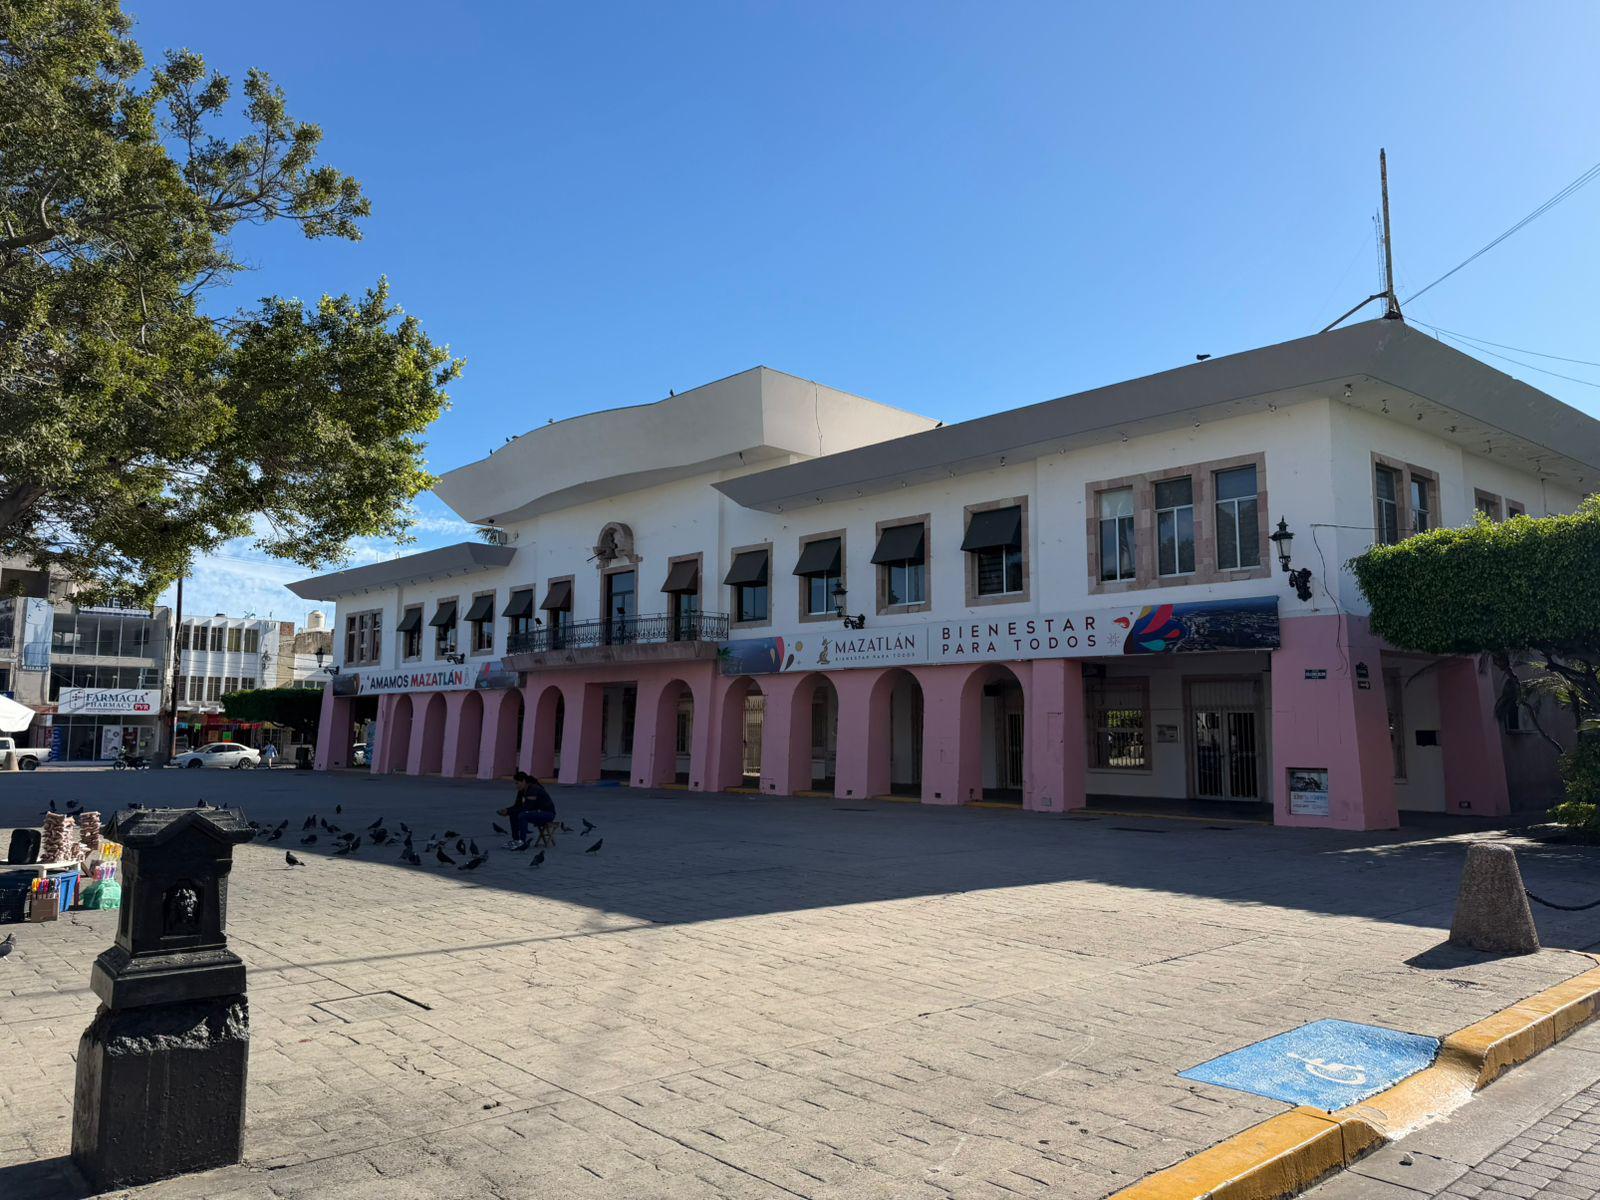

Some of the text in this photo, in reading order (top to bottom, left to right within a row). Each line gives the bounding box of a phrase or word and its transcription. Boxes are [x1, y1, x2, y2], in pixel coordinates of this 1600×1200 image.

[942, 616, 1095, 640] BIENESTAR
[835, 632, 915, 654] MAZATLÁN
[942, 635, 1096, 655] PARA TODOS
[370, 669, 463, 690] AMAMOS MAZATLÁN
[86, 693, 146, 703] FARMACIA
